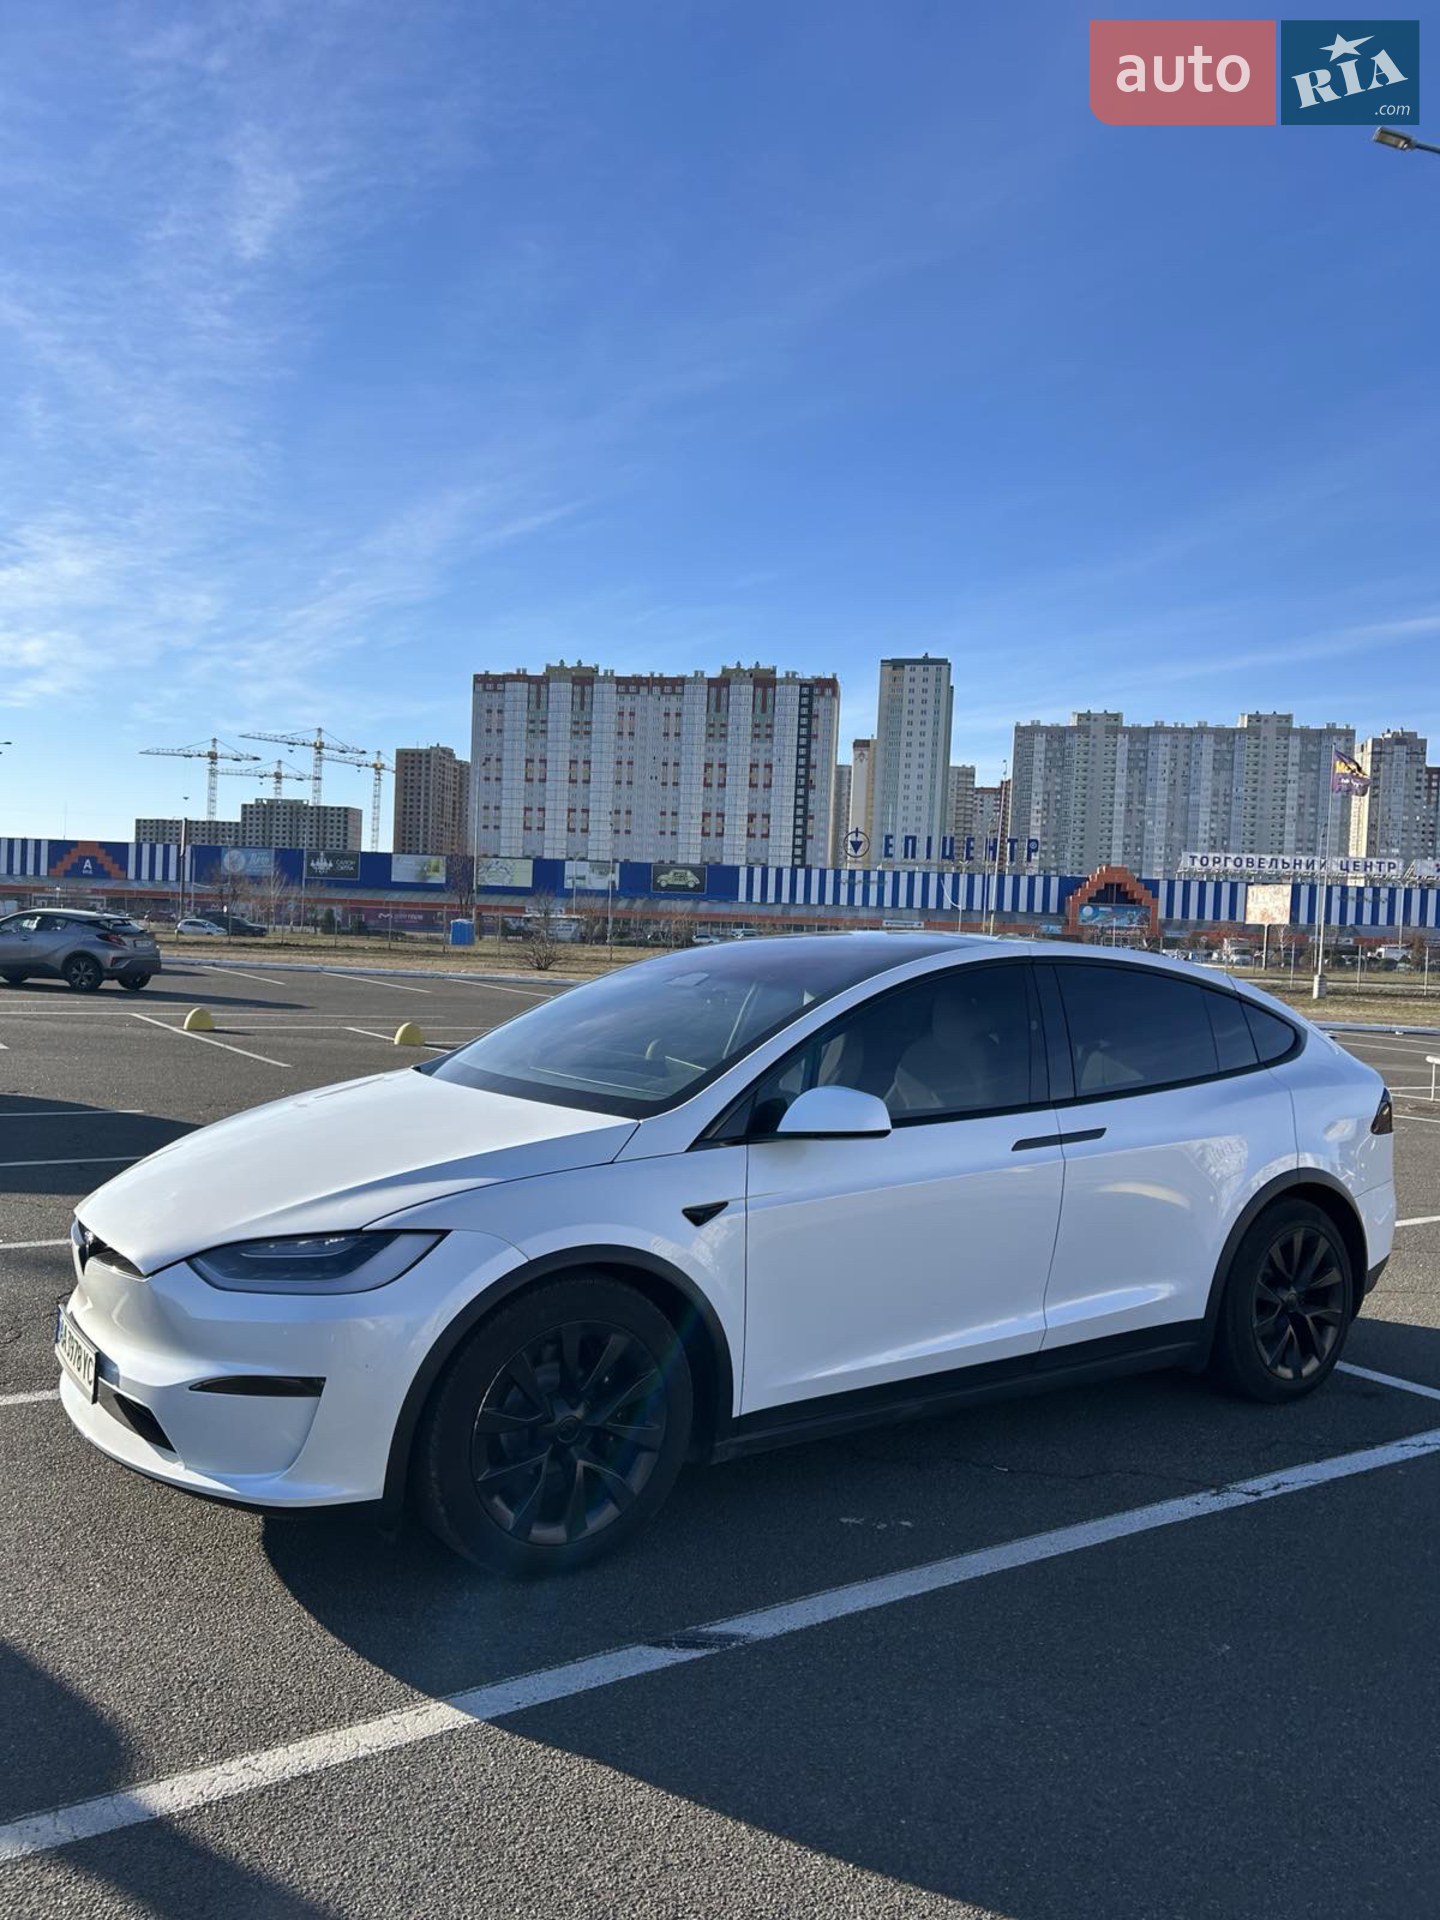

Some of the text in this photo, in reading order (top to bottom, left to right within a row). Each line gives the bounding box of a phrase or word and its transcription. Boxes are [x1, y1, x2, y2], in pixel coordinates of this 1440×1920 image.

[883, 834, 1040, 863] ЕПІЦЕНТР
[1188, 854, 1398, 874] ТОРГОВЕЛЬНИЙ ЦЕНТР
